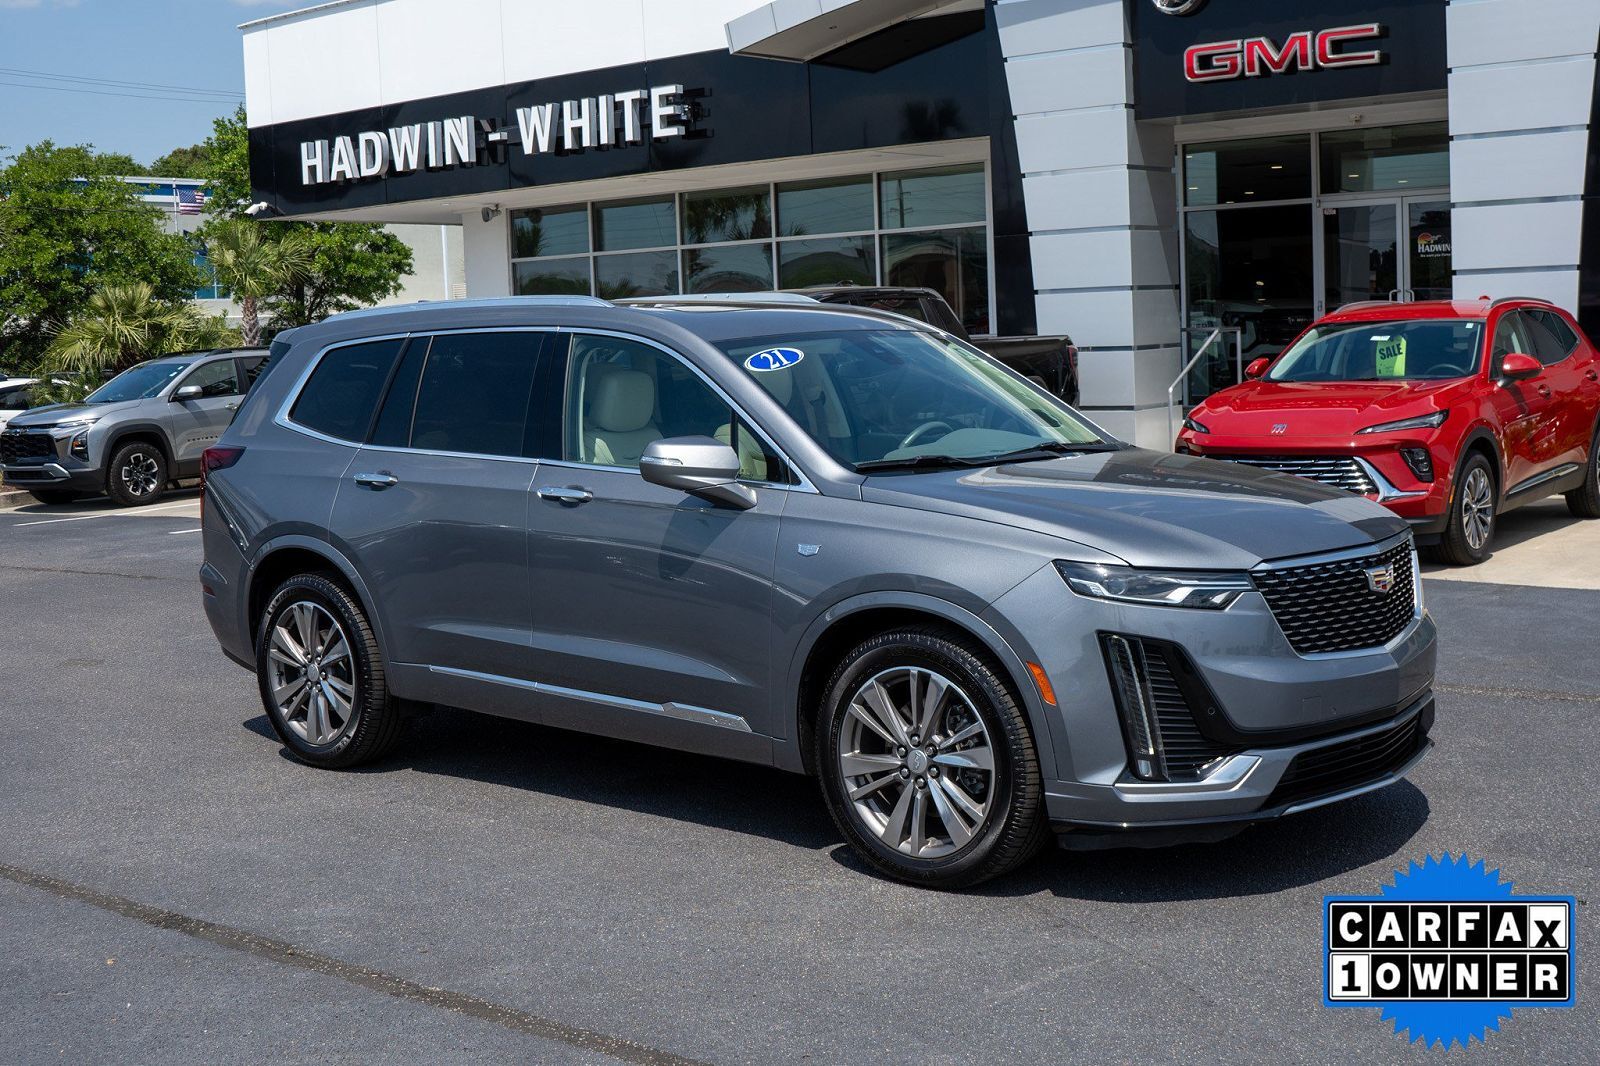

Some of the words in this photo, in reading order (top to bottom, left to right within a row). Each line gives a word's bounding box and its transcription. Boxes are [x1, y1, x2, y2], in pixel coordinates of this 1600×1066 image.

[1184, 22, 1381, 83] GMC
[300, 115, 477, 186] HADWIN
[515, 83, 686, 156] WHITE
[1418, 243, 1451, 253] HADWIN
[760, 349, 791, 369] 21
[1379, 344, 1403, 360] SALE
